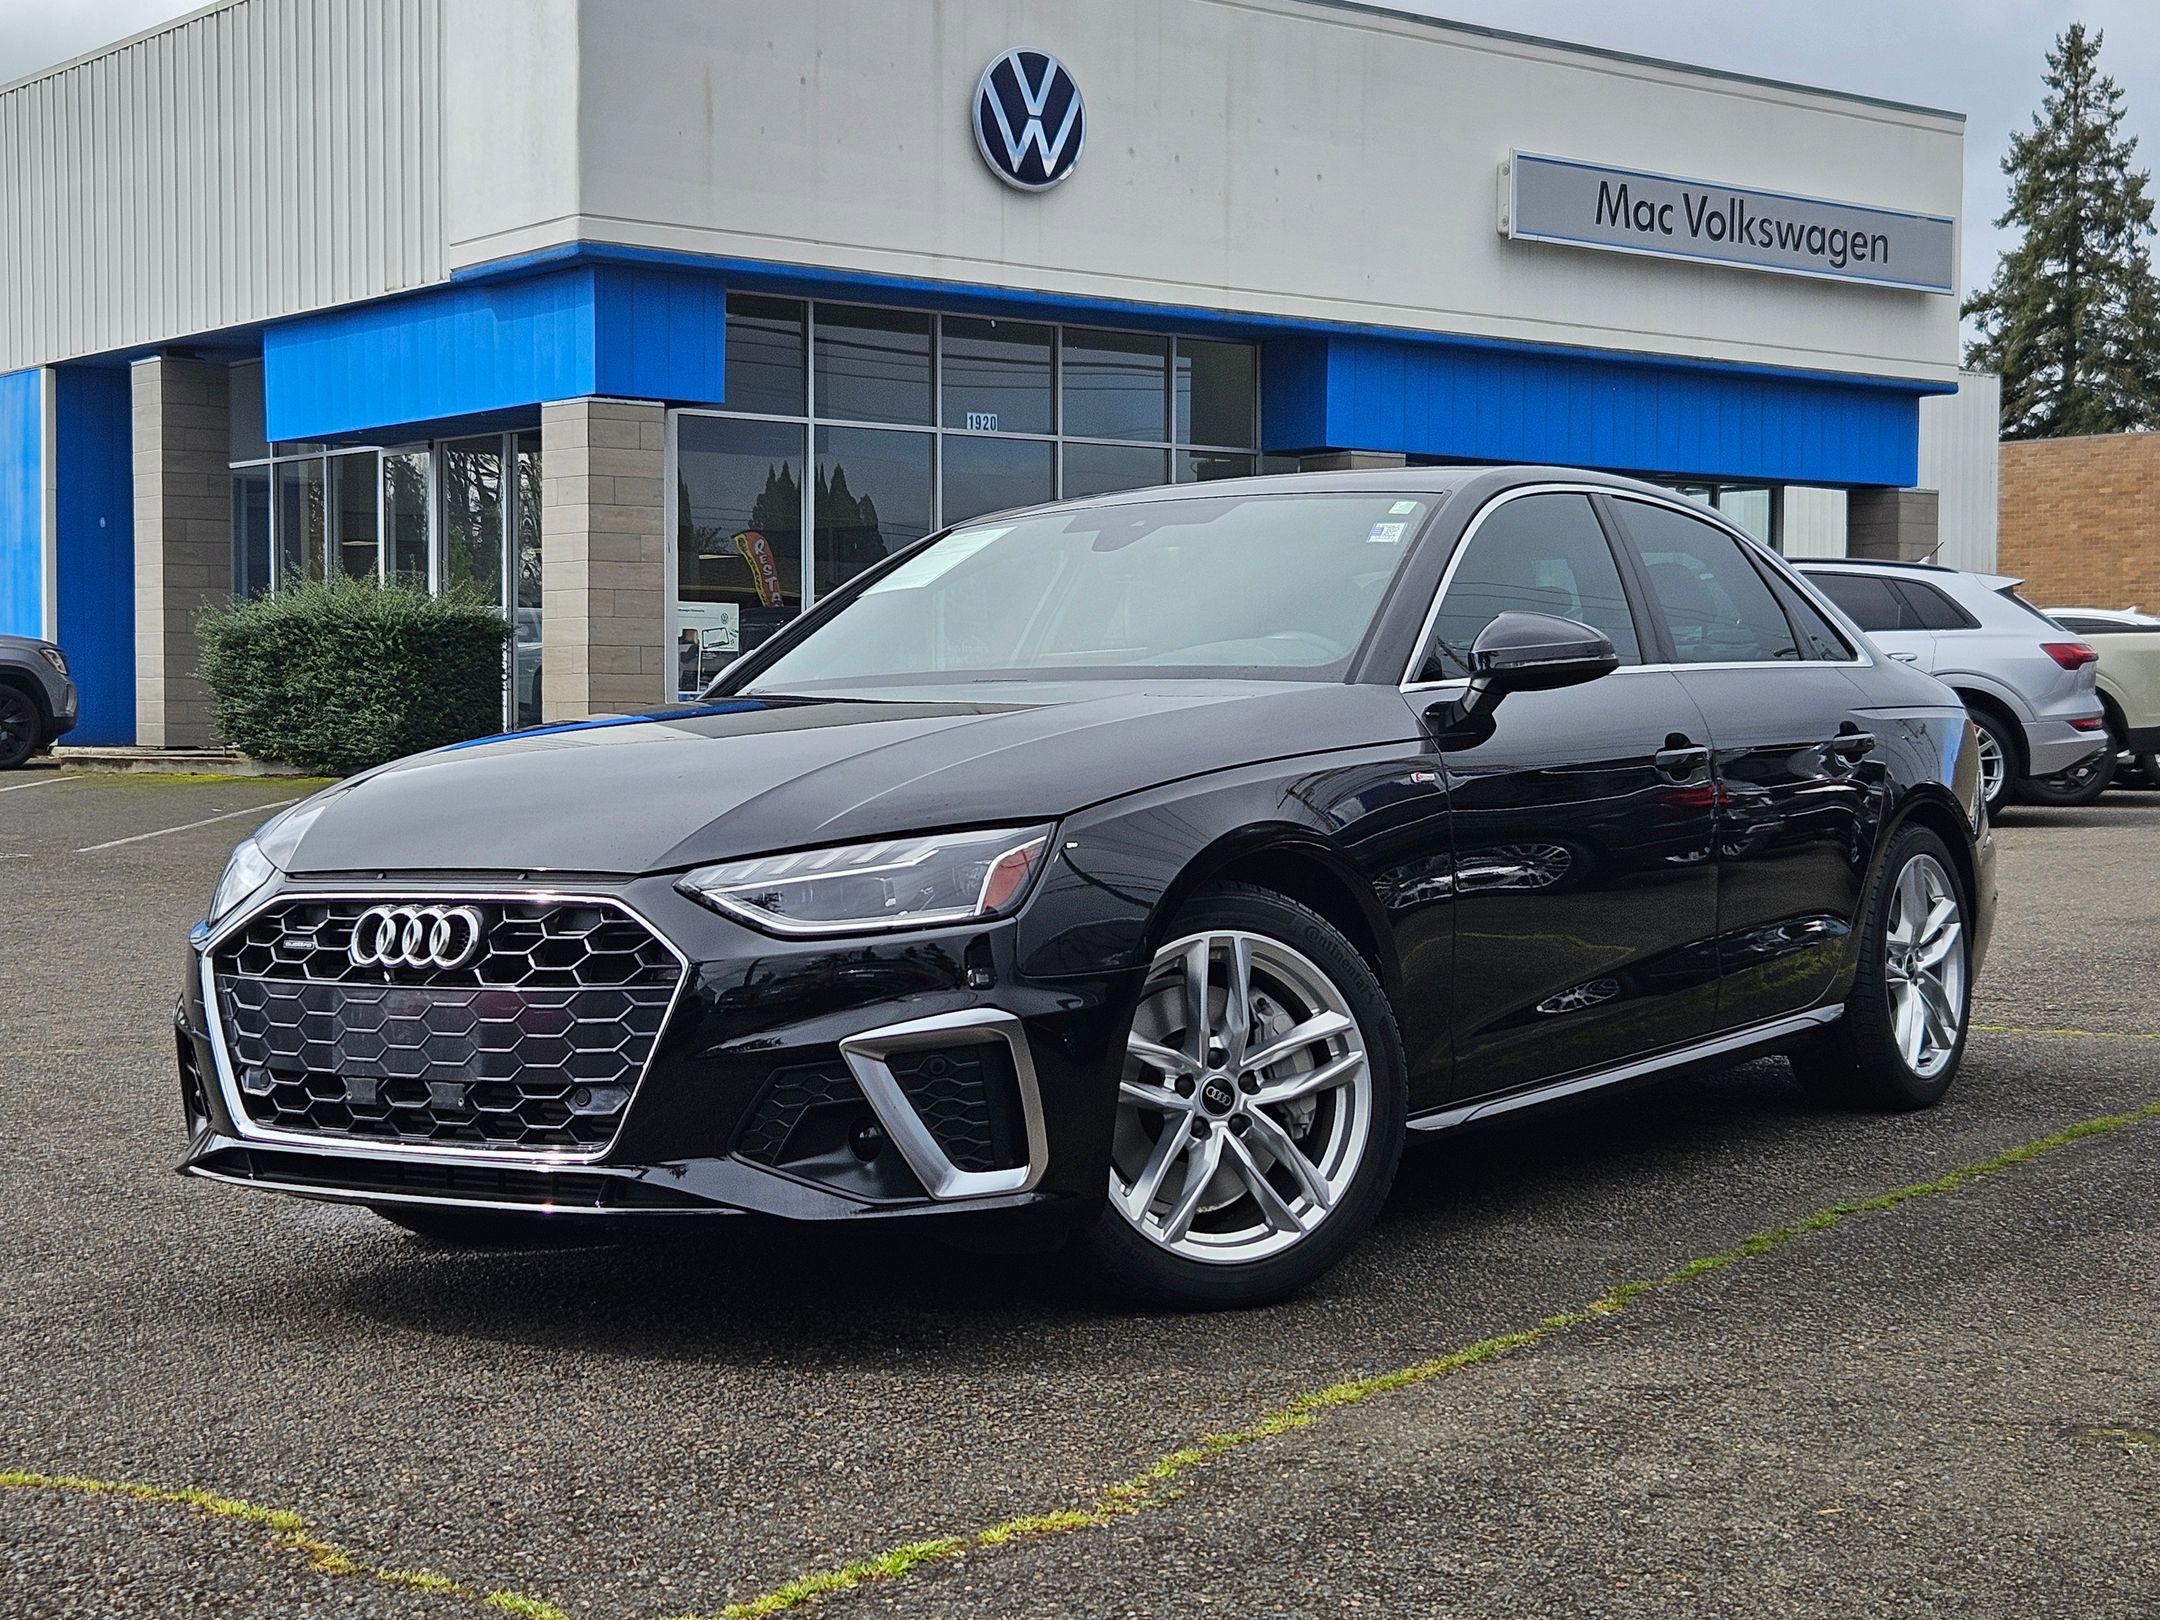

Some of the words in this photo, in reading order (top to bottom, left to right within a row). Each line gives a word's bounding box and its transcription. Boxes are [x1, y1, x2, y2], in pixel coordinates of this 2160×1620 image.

[1594, 180, 1674, 236] Mac
[1681, 192, 1889, 269] Volkswagen
[968, 414, 997, 431] 1920
[754, 538, 784, 607] RESTA
[1304, 924, 1370, 994] Continental
